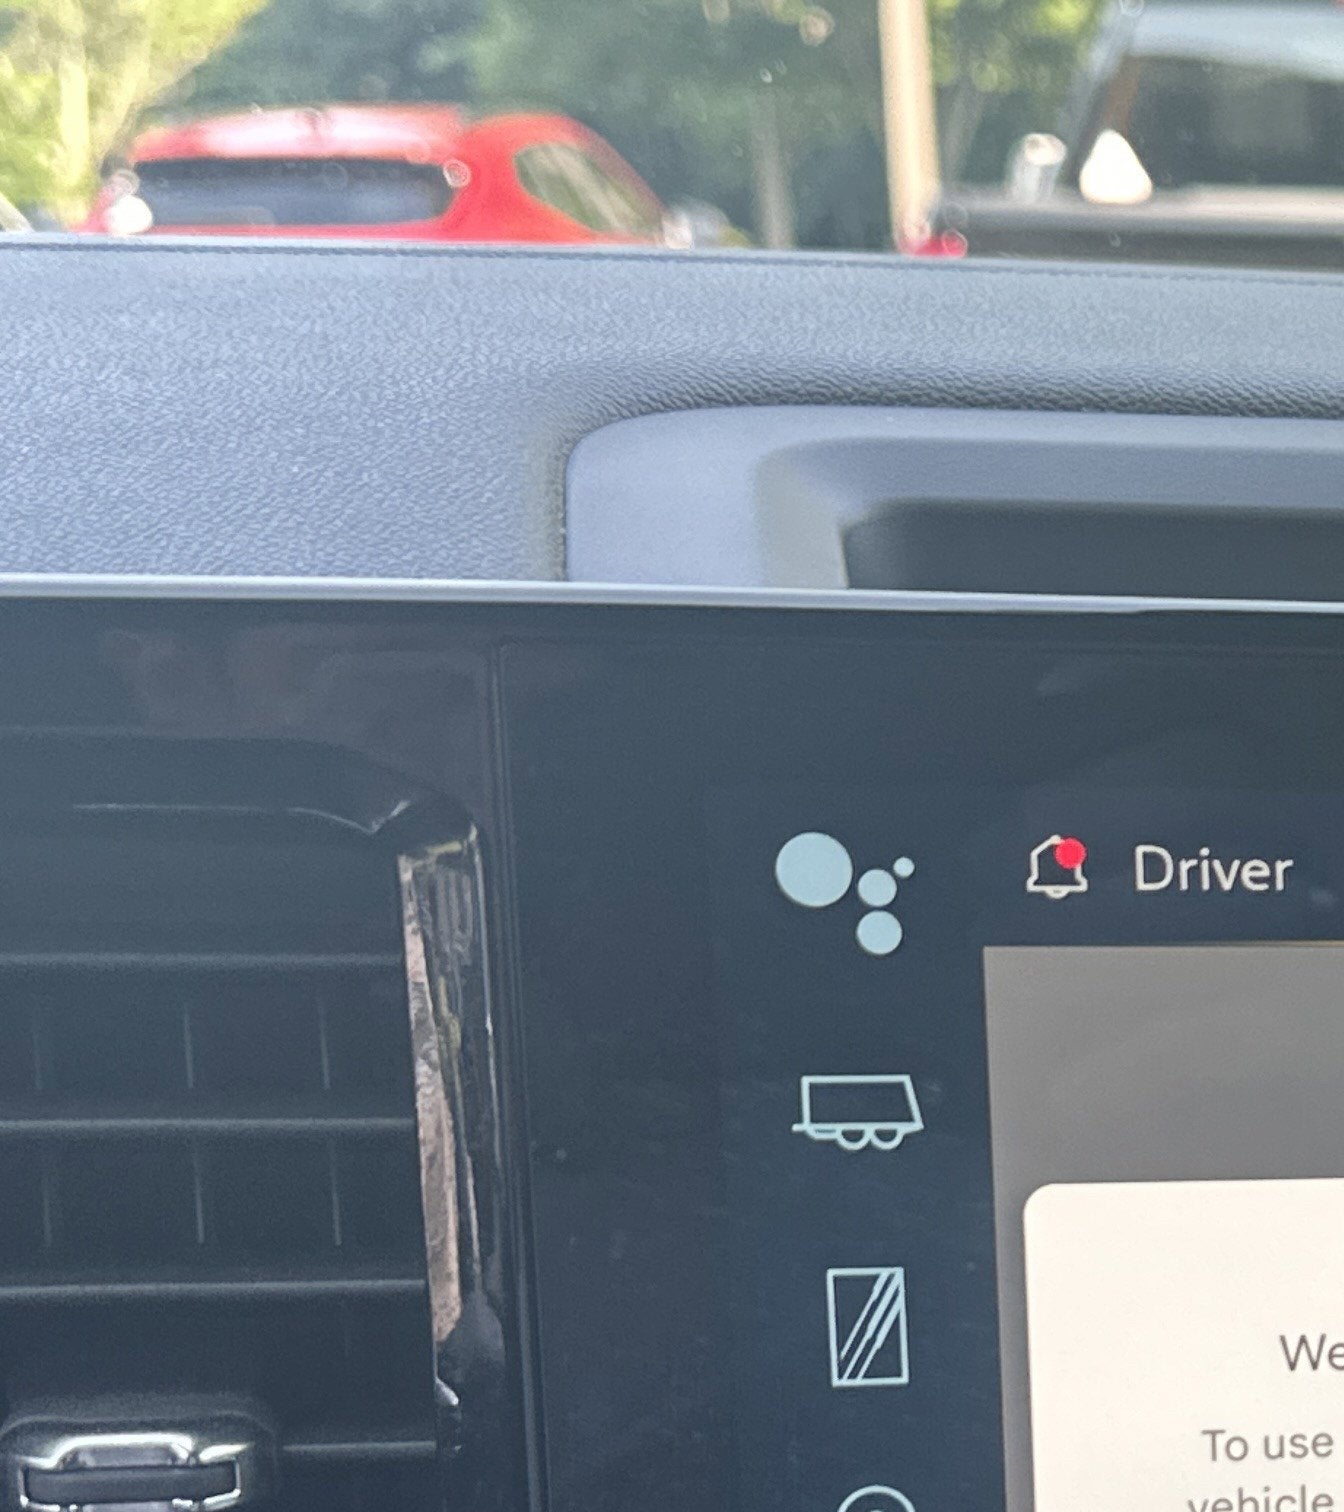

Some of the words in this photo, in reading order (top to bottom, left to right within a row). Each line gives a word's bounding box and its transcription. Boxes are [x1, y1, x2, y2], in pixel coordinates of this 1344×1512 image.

[1134, 844, 1293, 892] Driver
[1201, 1428, 1250, 1462] To
[1263, 1432, 1334, 1461] use
